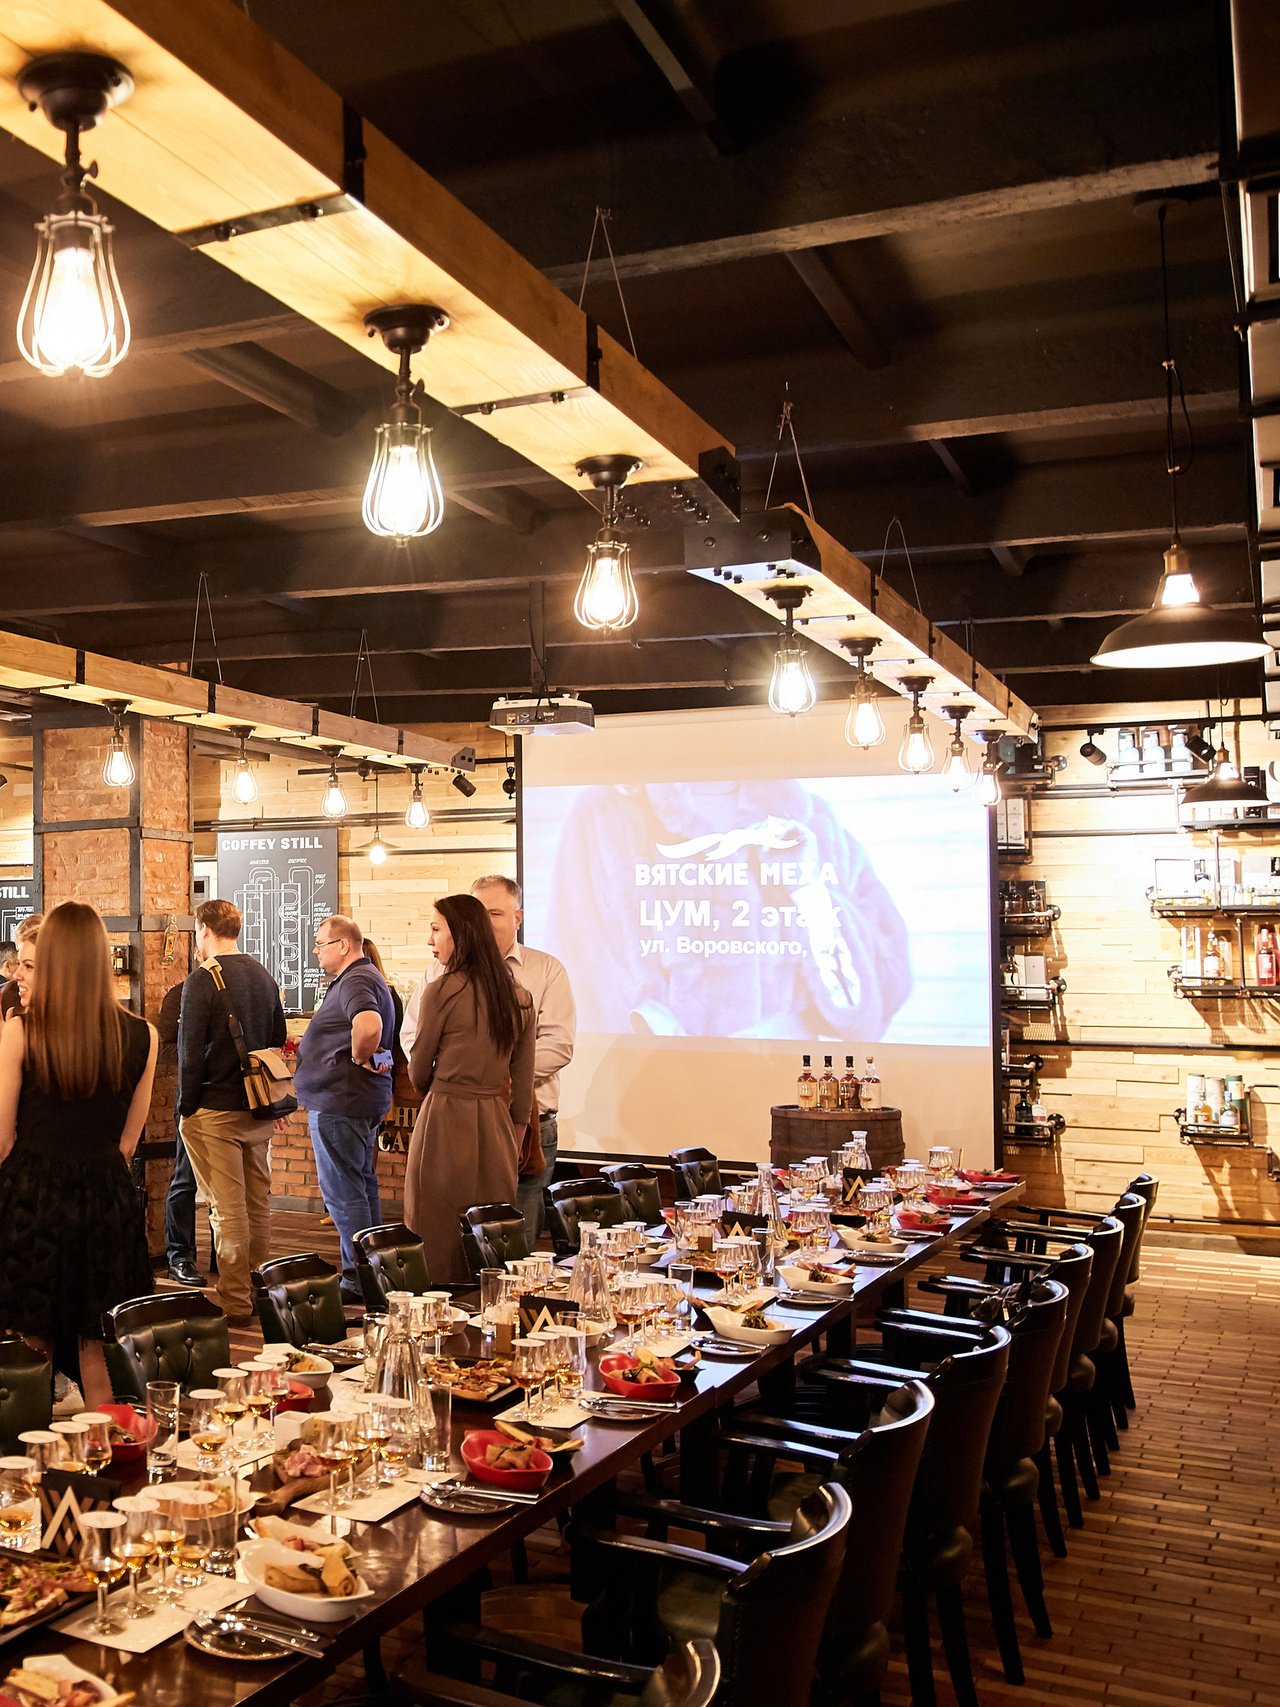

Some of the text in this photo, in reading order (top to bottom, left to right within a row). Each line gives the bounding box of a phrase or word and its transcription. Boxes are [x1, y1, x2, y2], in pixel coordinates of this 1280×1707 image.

[221, 836, 324, 852] COFFEY STILL
[635, 861, 839, 886] ВЯТСКИЕ МЕХА
[639, 899, 841, 932] ЦУМ, 2 эта
[640, 938, 670, 958] ул.
[676, 936, 808, 959] Воровского,
[377, 1130, 413, 1152] CA
